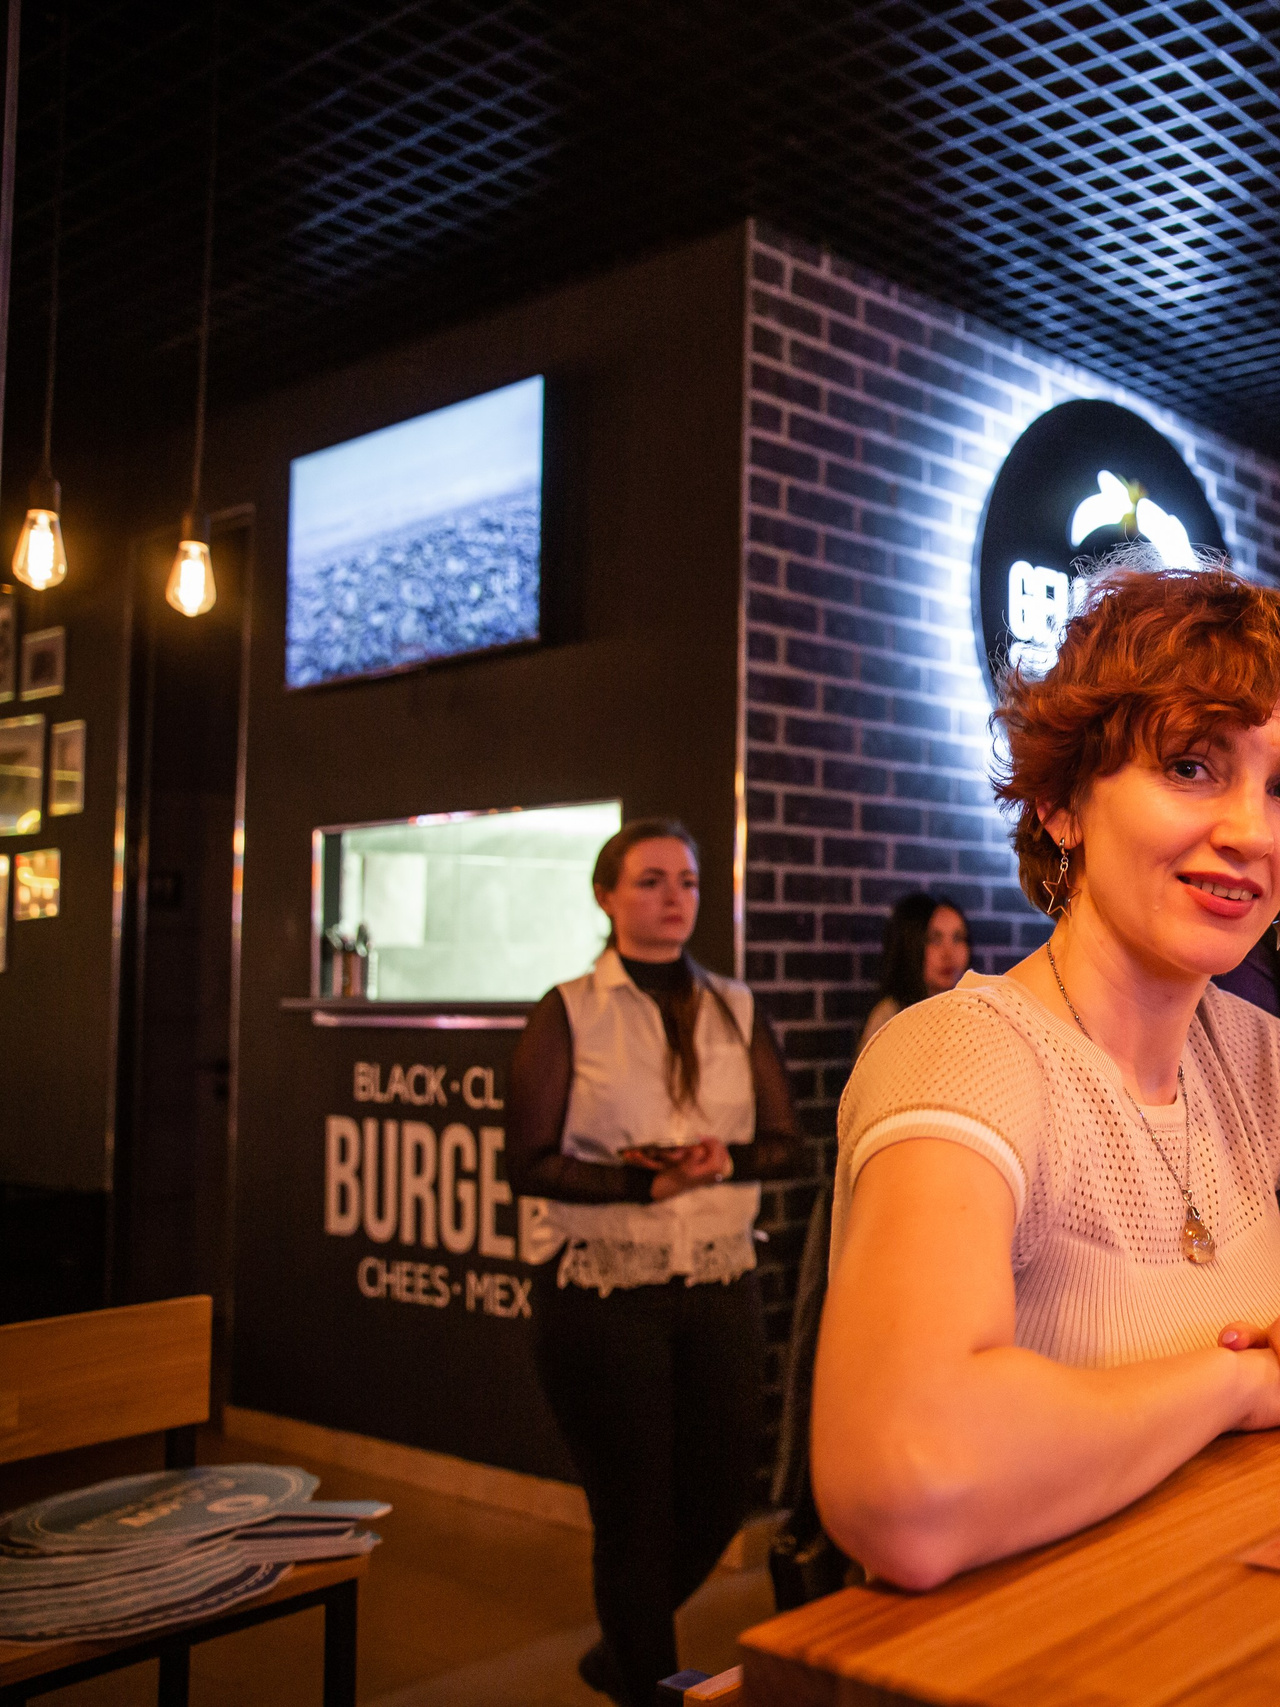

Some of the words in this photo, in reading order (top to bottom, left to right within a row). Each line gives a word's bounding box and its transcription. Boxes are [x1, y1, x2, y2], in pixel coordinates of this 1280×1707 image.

[353, 1061, 448, 1107] BLACK
[461, 1066, 504, 1110] CL
[357, 1256, 449, 1309] CHEES
